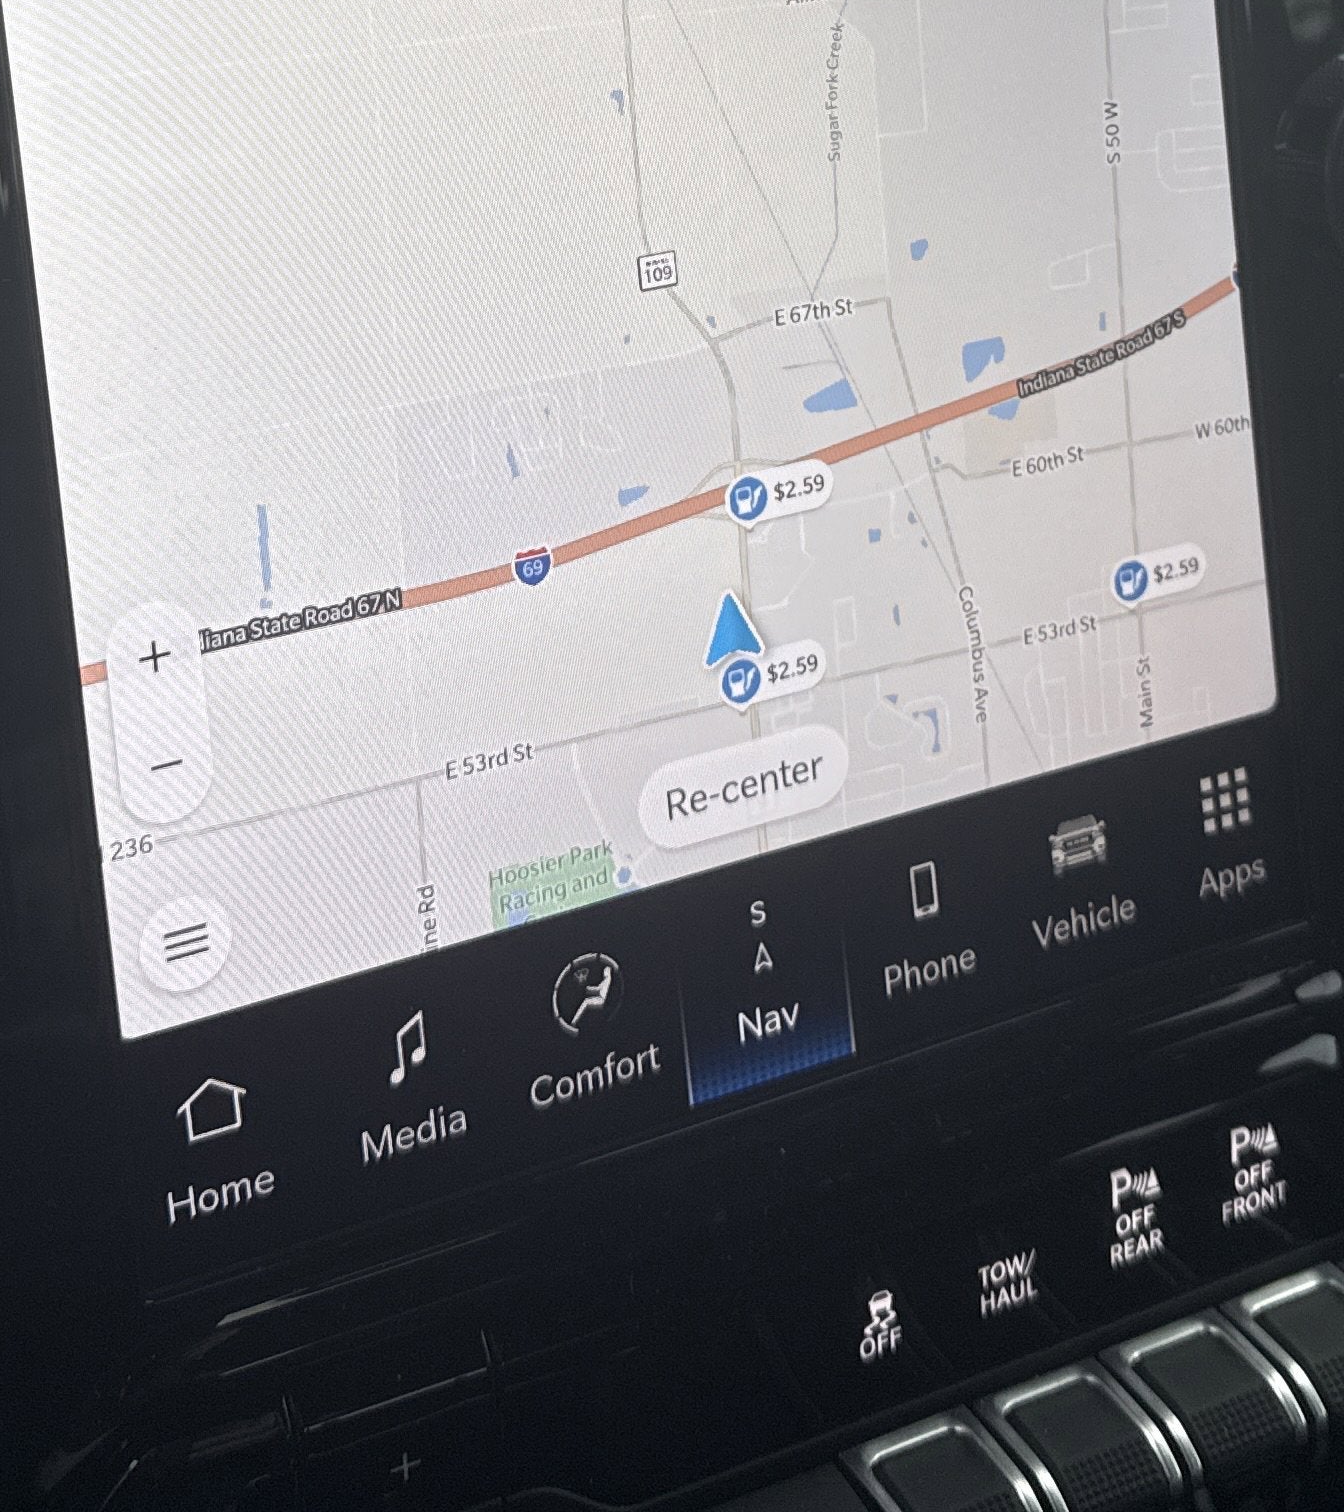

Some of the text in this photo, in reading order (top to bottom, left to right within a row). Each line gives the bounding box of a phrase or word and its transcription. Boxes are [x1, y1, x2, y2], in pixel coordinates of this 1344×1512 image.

[825, 23, 845, 163] Sugar Fork Creek
[1103, 101, 1121, 164] S 50 W
[644, 264, 673, 283] 109
[774, 299, 853, 327] E 67th St
[1018, 310, 1186, 396] Indiana State Road 67 S
[1195, 416, 1250, 439] W 60th
[1012, 446, 1085, 477] E 60th St
[773, 475, 825, 502] $2.59
[522, 561, 543, 577] 69
[1154, 557, 1199, 584] $2.59
[199, 589, 400, 652] iana State Road 67 N
[1024, 615, 1097, 646] E 53rd St
[767, 655, 819, 683] $2.59
[959, 586, 988, 724] Columbus Ave
[1138, 656, 1154, 728] Main St
[446, 743, 535, 780] E 53rd St
[666, 753, 824, 821] Re-center
[110, 834, 154, 862] 236
[488, 839, 613, 888] Hoosier Park
[499, 866, 608, 914] Racing and
[1199, 857, 1266, 899] Apps
[417, 884, 435, 915] Rd
[749, 901, 767, 927] S
[1031, 895, 1137, 950] Vehicle
[883, 946, 978, 998] Phone
[737, 1001, 800, 1043] Nav
[530, 1042, 661, 1107] Comfort
[361, 1106, 469, 1166] Media
[166, 1165, 276, 1225] Home
[1235, 1161, 1274, 1192] OFF
[1116, 1204, 1155, 1237] OFF
[1222, 1179, 1287, 1228] FRONT
[978, 1248, 1037, 1289] TOW/
[1110, 1229, 1164, 1270] REAR
[980, 1278, 1039, 1320] HAUL
[859, 1326, 903, 1362] OFF
